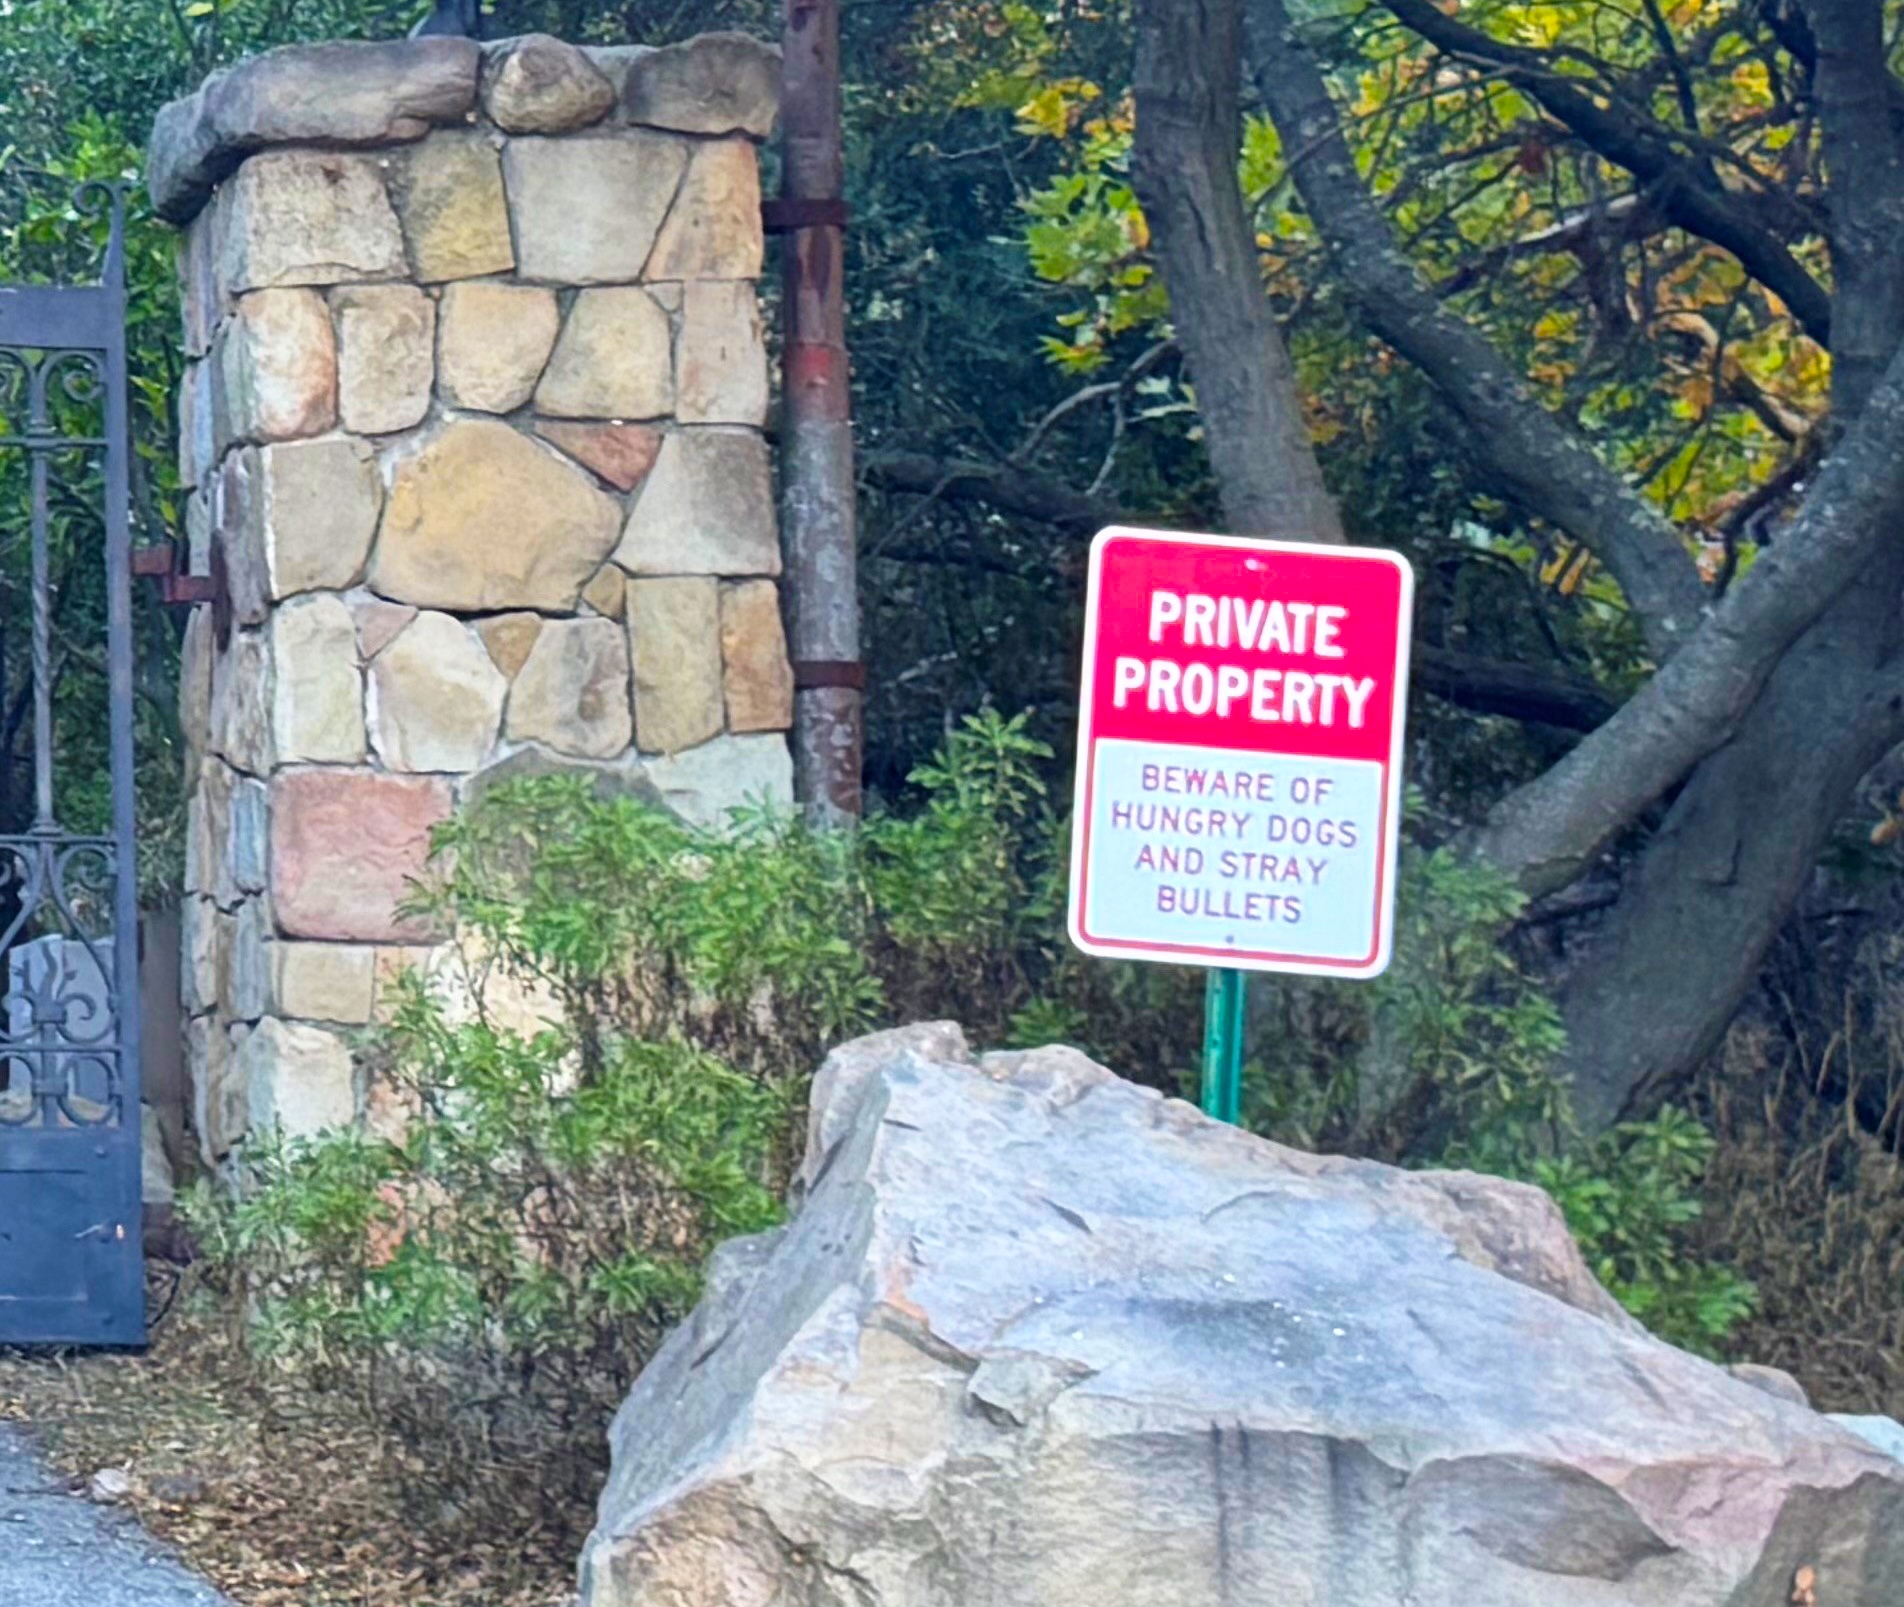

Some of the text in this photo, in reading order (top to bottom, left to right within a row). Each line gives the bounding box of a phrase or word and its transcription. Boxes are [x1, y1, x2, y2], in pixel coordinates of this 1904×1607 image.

[1149, 590, 1347, 658] PRIVATE
[1113, 656, 1375, 728] PROPERTY
[1141, 763, 1334, 805] BEWARE OF
[1111, 801, 1357, 848] HUNGRY DOGS
[1134, 843, 1328, 885] AND STRAY
[1157, 884, 1302, 924] BULLETS
